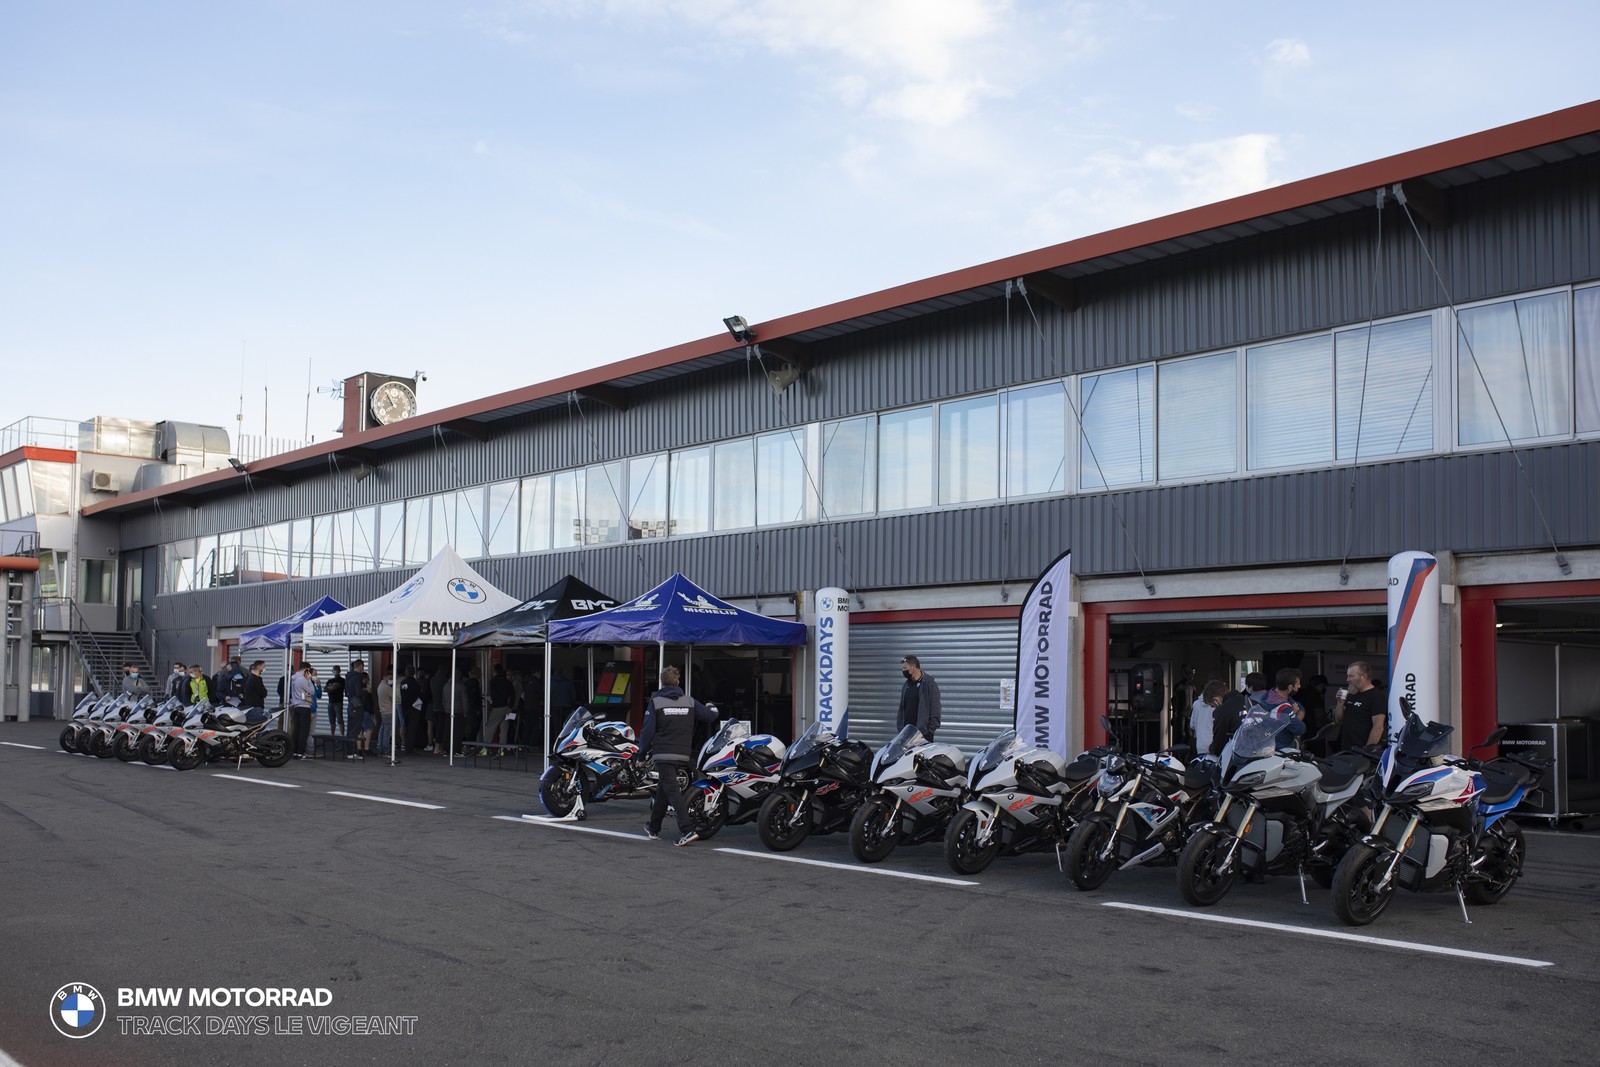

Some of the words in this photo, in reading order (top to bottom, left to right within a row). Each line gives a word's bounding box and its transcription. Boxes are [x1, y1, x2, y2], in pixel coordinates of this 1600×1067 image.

[570, 599, 615, 611] BMC
[683, 607, 738, 616] MICHELIN
[312, 622, 332, 636] BMW
[334, 621, 384, 636] MOTORRAD
[1034, 581, 1053, 698] MOTORRAD
[819, 616, 834, 734] TRACKDAYS
